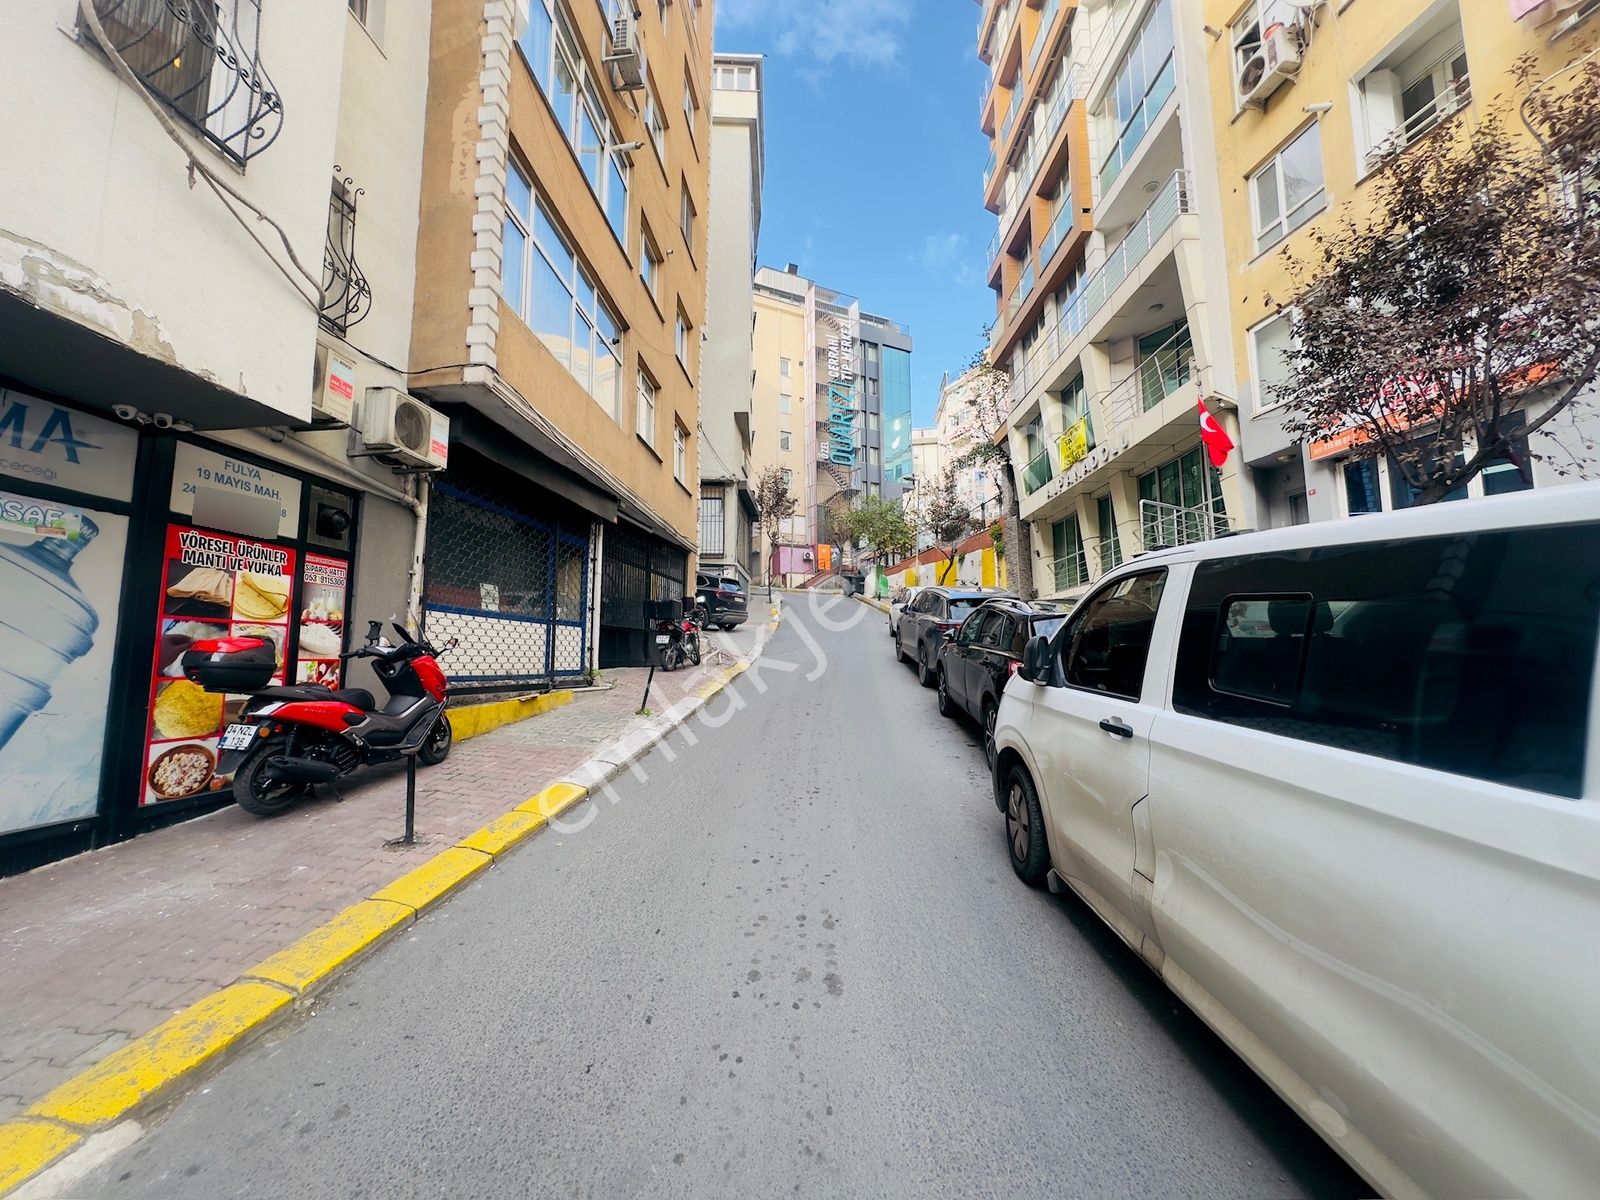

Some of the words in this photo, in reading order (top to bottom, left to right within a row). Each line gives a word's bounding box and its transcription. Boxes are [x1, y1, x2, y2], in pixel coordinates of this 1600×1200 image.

[829, 386, 856, 466] QUARTZ
[197, 467, 211, 480] 19
[214, 472, 251, 491] MAYIS
[254, 484, 281, 500] MAH.
[224, 460, 261, 480] FULYA
[180, 531, 235, 555] YÖRESEL
[238, 541, 287, 565] ÜRÜNLER
[182, 550, 227, 569] MANTI
[230, 557, 244, 571] VE
[247, 560, 282, 576] YUFKA
[227, 725, 238, 734] 34
